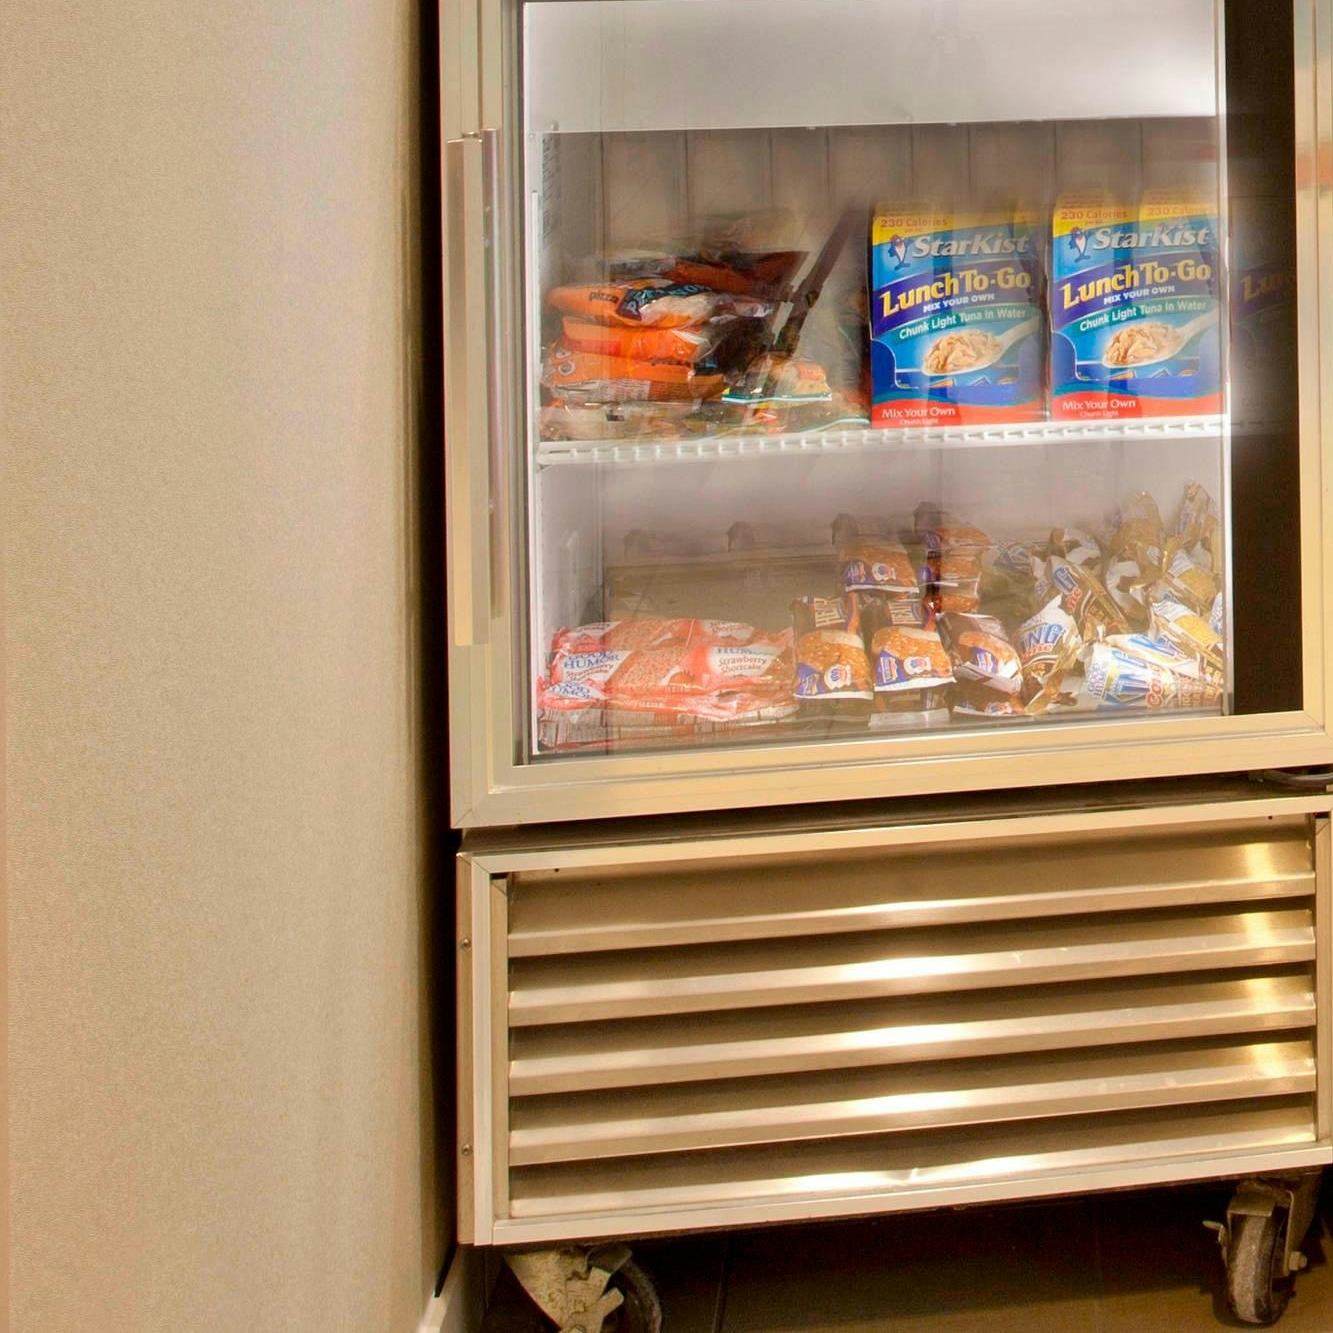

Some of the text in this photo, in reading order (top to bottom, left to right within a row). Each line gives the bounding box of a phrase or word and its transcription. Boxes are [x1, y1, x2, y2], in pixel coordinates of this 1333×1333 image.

[880, 216, 948, 228] 230 Calories
[1061, 208, 1129, 221] 230 Calories
[912, 233, 1030, 259] StarKist
[1092, 224, 1210, 251] StarKist
[882, 265, 1032, 318] Lunch To-Go
[1061, 257, 1212, 310] Lunch To-Go
[588, 291, 619, 304] pizza
[922, 292, 995, 314] MIX YOUR OWN
[1103, 285, 1175, 306] MIX YOUR OWN
[898, 321, 929, 341] Chunk
[931, 314, 957, 331] Light
[959, 311, 982, 324] Tuna
[997, 307, 1026, 320] Water
[1079, 313, 1109, 332] Chunk
[1111, 306, 1137, 323] Light
[1139, 303, 1163, 316] Tuna
[1177, 299, 1207, 312] Water
[882, 406, 956, 418] Mix Your Own
[1062, 398, 1136, 411] Mix Your Own
[564, 655, 620, 669] HUMOR
[719, 655, 767, 666] Strawberry
